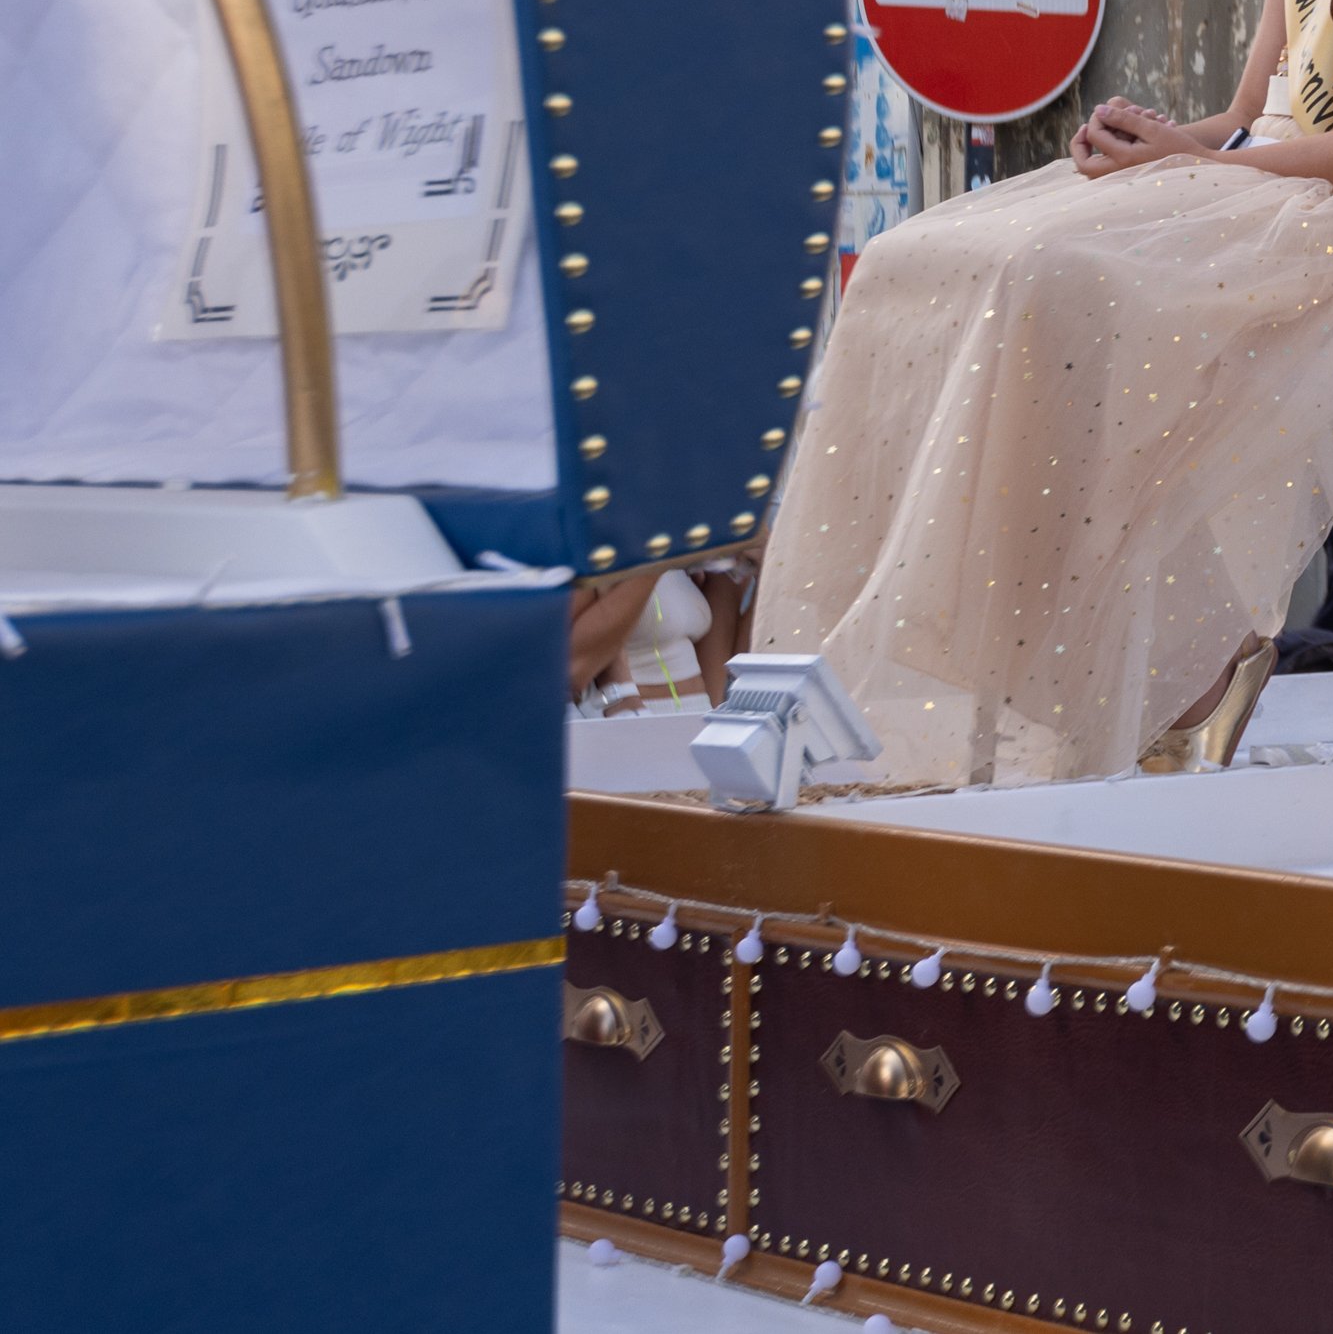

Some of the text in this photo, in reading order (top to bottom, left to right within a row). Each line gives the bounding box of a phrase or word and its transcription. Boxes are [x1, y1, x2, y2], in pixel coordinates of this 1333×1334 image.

[307, 43, 435, 86] Sandown
[335, 118, 374, 153] of
[375, 108, 466, 158] Wight
